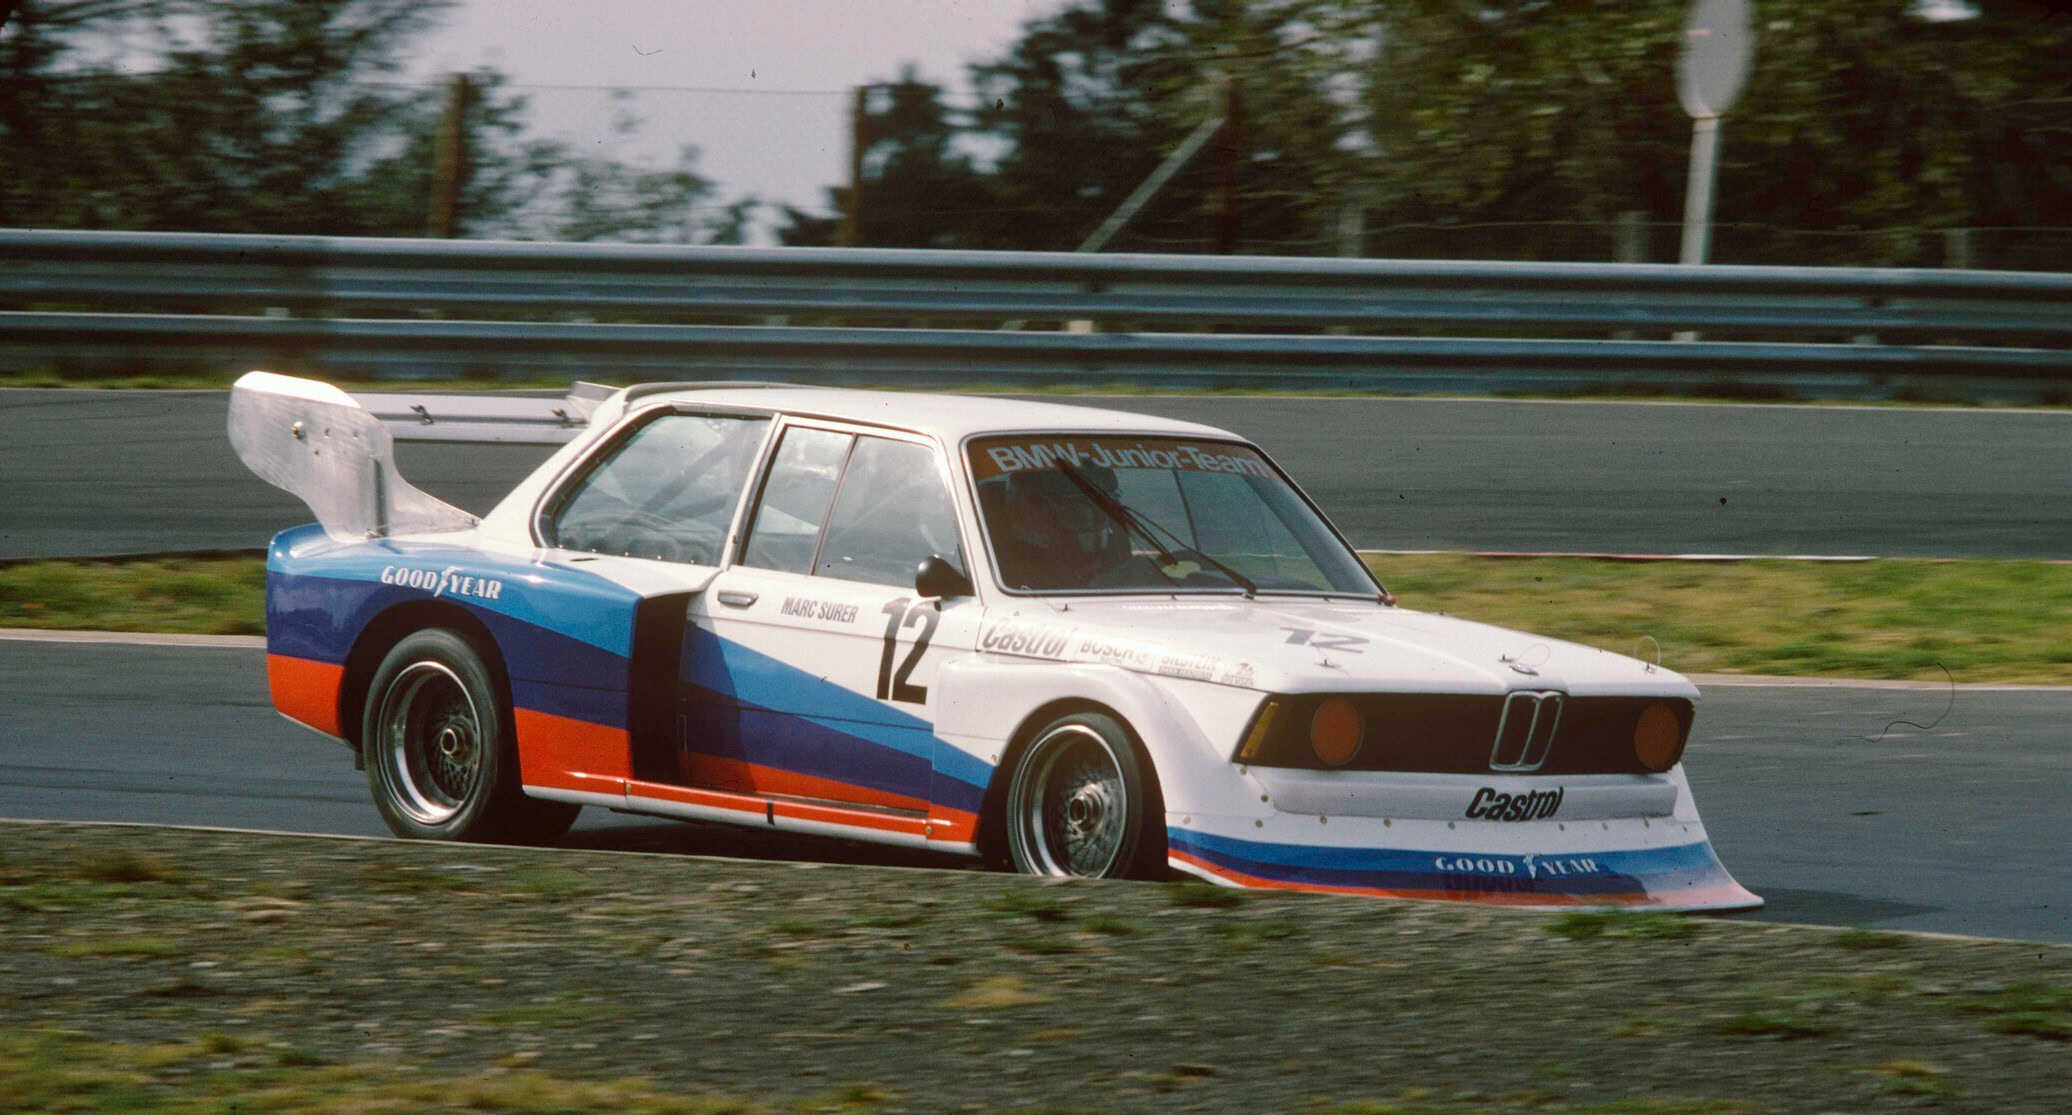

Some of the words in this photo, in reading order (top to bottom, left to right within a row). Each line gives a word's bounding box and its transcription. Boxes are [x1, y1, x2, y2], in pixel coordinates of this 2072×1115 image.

[781, 597, 818, 618] MARC
[817, 601, 859, 624] SURER
[877, 597, 941, 705] 12
[1465, 786, 1564, 822] Castrol
